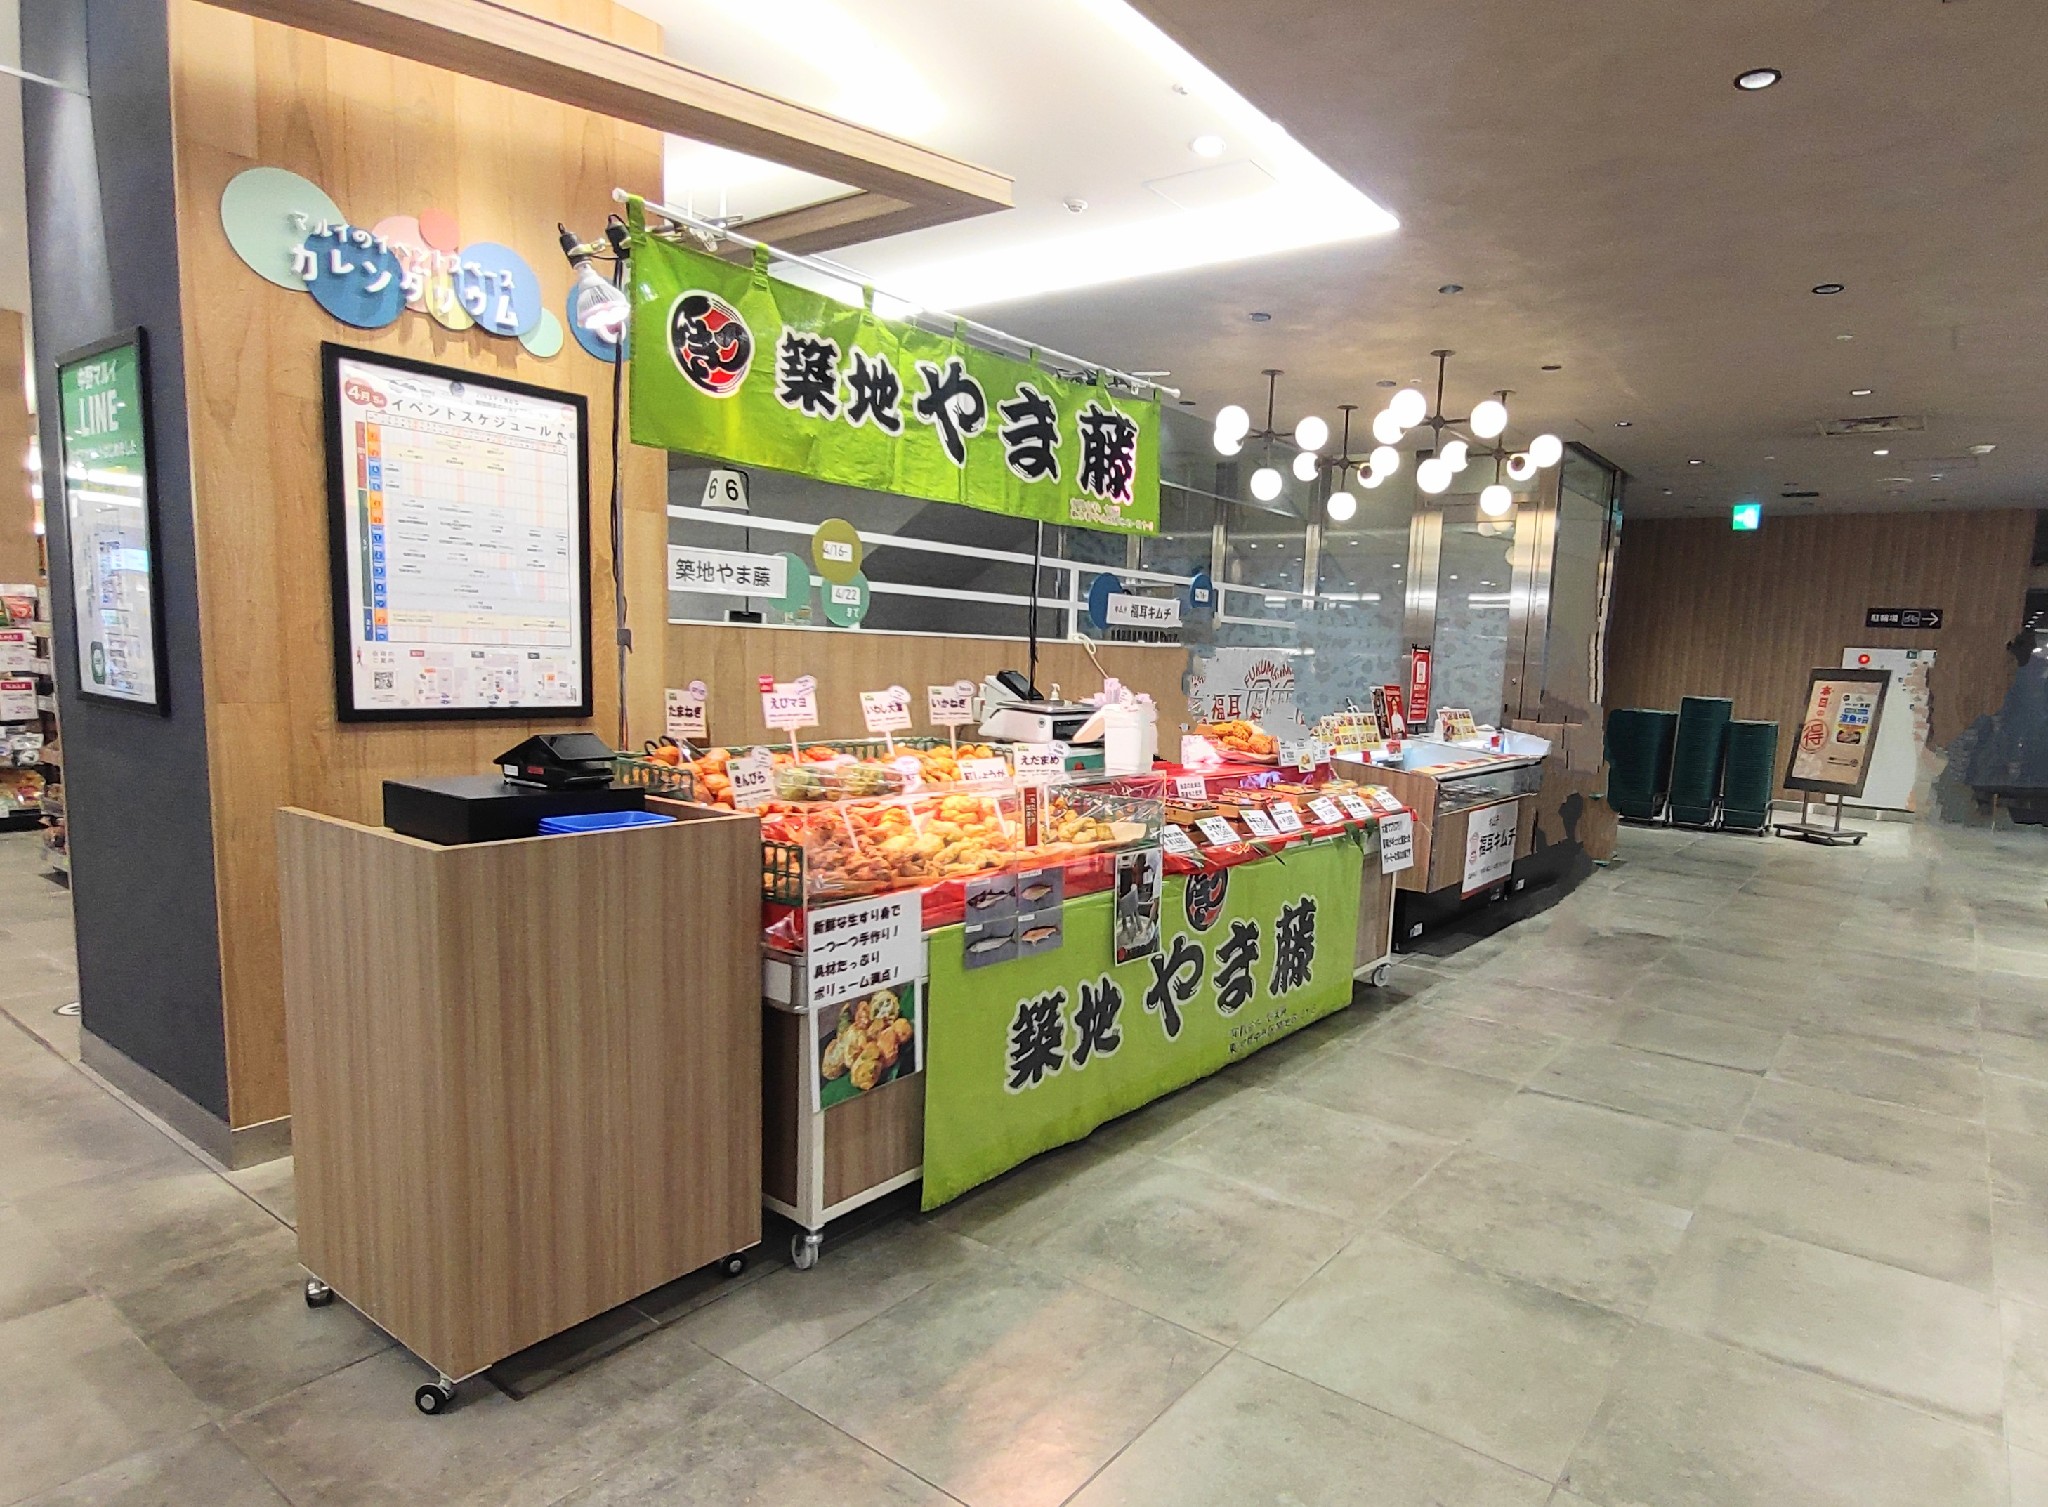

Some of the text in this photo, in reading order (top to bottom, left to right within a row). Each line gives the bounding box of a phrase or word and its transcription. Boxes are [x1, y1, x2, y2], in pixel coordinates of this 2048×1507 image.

[291, 244, 519, 327] カレンダリウム
[79, 389, 118, 437] LINE
[392, 399, 551, 437] イベントスケジュール
[774, 330, 1140, 504] 築地やま藤
[708, 478, 718, 499] 6
[725, 479, 738, 500] 6
[675, 557, 771, 587] 築地やま藤
[1130, 604, 1172, 620] 福耳キムチ
[668, 705, 703, 719] たまねぎ
[770, 697, 807, 709] えびマヨ
[1020, 755, 1060, 766] えだまめ
[733, 770, 767, 789] きんぴら
[813, 903, 901, 935] 新鮮な生すり身で
[814, 951, 880, 979] 具材たっぷり
[1003, 894, 1317, 1093] 築地やま藤
